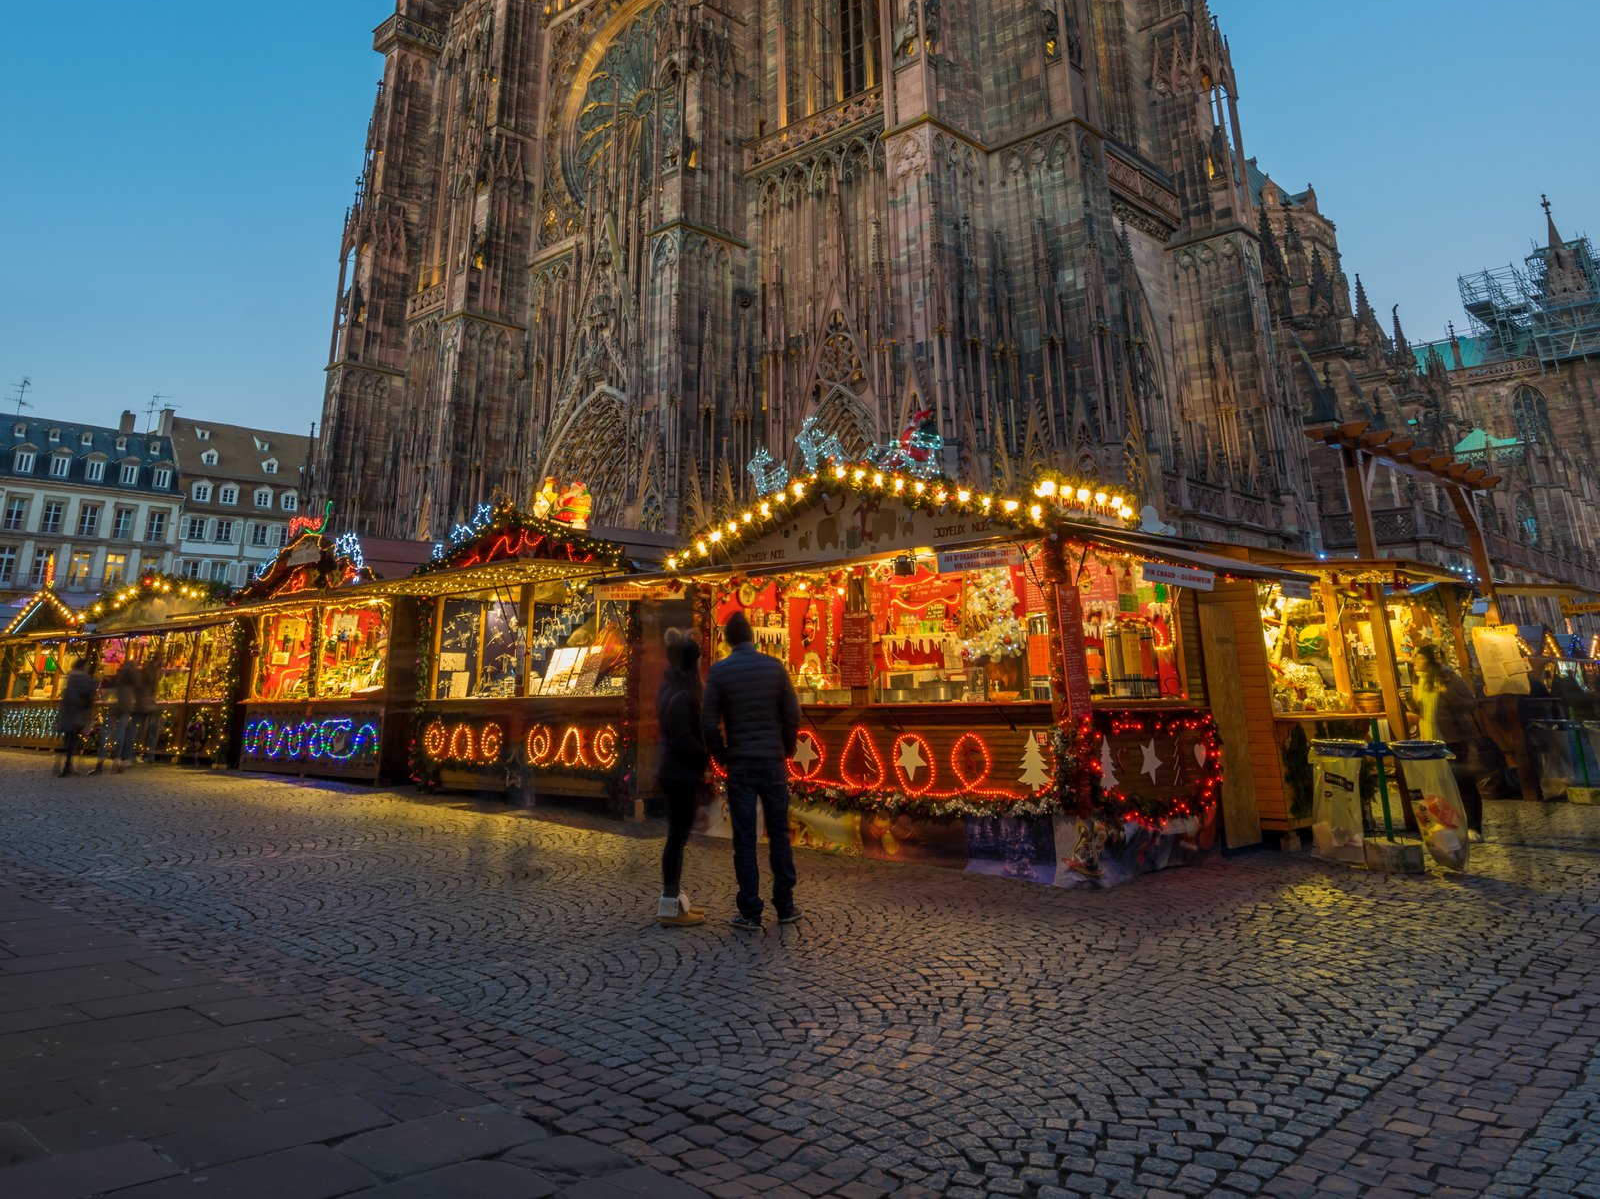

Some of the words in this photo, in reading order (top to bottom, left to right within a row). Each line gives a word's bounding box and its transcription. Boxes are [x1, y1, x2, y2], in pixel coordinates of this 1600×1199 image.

[933, 523, 966, 539] JOYEUX
[954, 552, 980, 561] D'ORANGE
[981, 550, 996, 559] CHAUD
[953, 562, 963, 570] VIN
[964, 561, 980, 569] CHAUD
[1145, 568, 1154, 576] VIN
[1156, 570, 1176, 579] CHAUD
[1181, 573, 1212, 584] GLÜHWEIN
